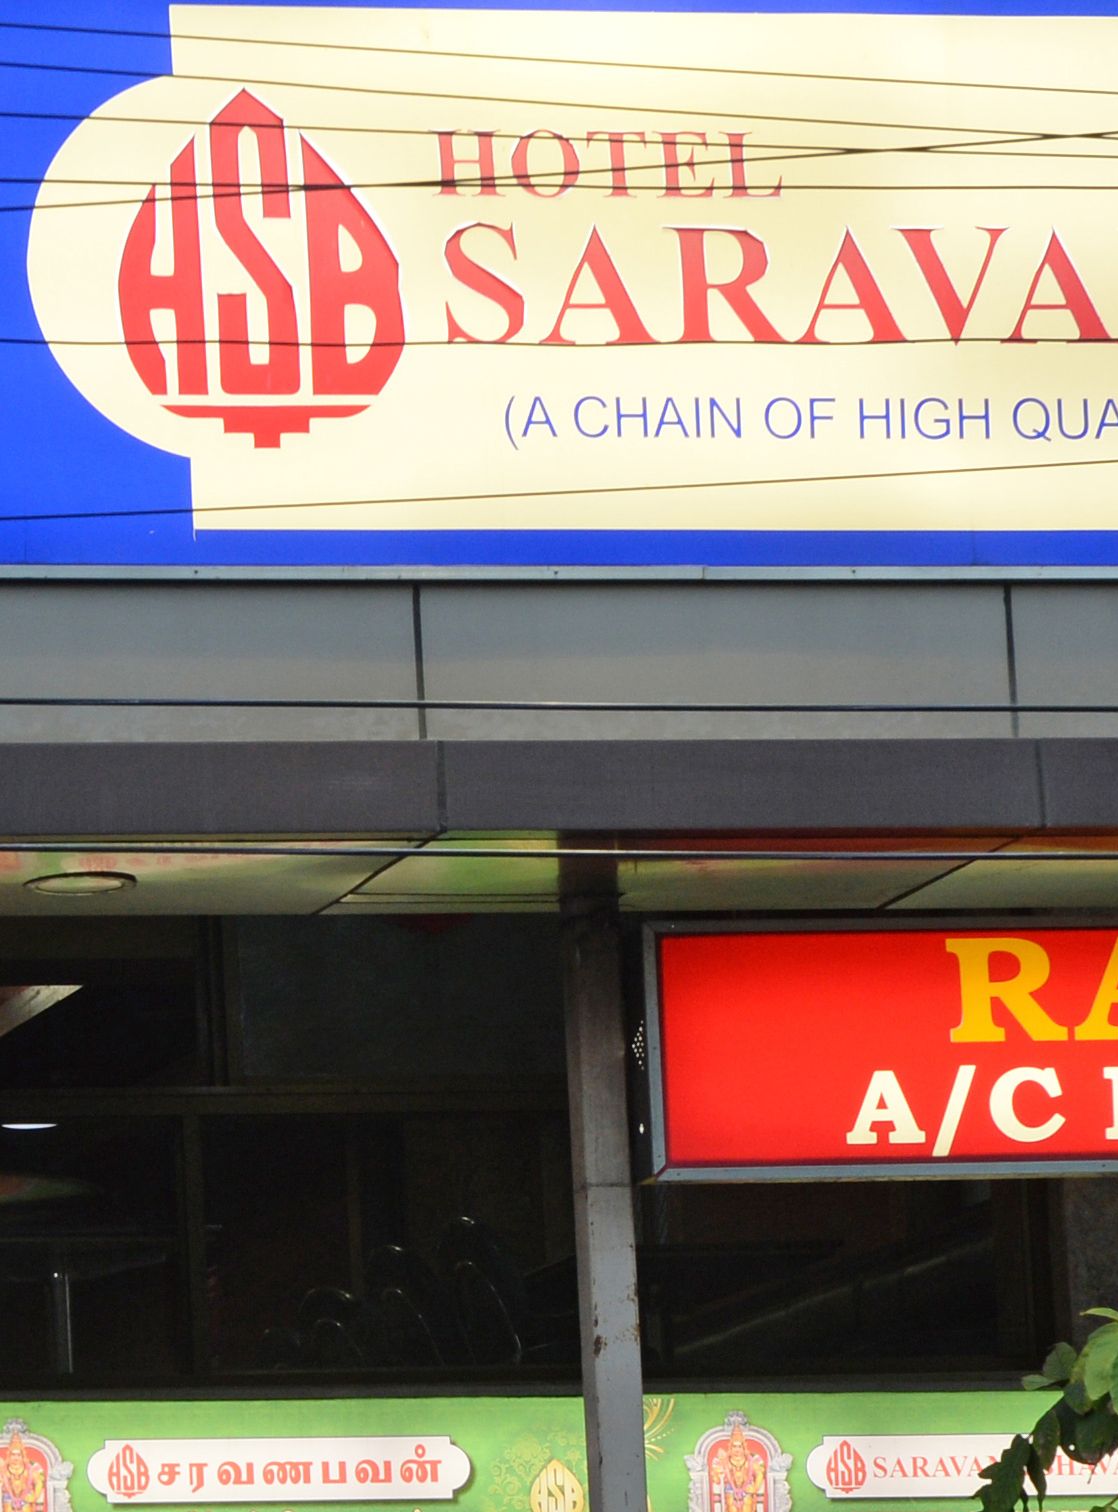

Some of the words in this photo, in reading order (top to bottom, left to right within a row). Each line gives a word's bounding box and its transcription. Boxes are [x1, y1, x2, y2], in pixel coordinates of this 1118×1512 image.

[429, 129, 783, 198] HOTEL
[504, 395, 558, 450] (A
[573, 396, 742, 438] CHAIN
[764, 397, 836, 439] OF
[858, 397, 991, 439] HIGH
[846, 1064, 1066, 1157] A/C
[872, 1455, 1030, 1479] SARAVA
